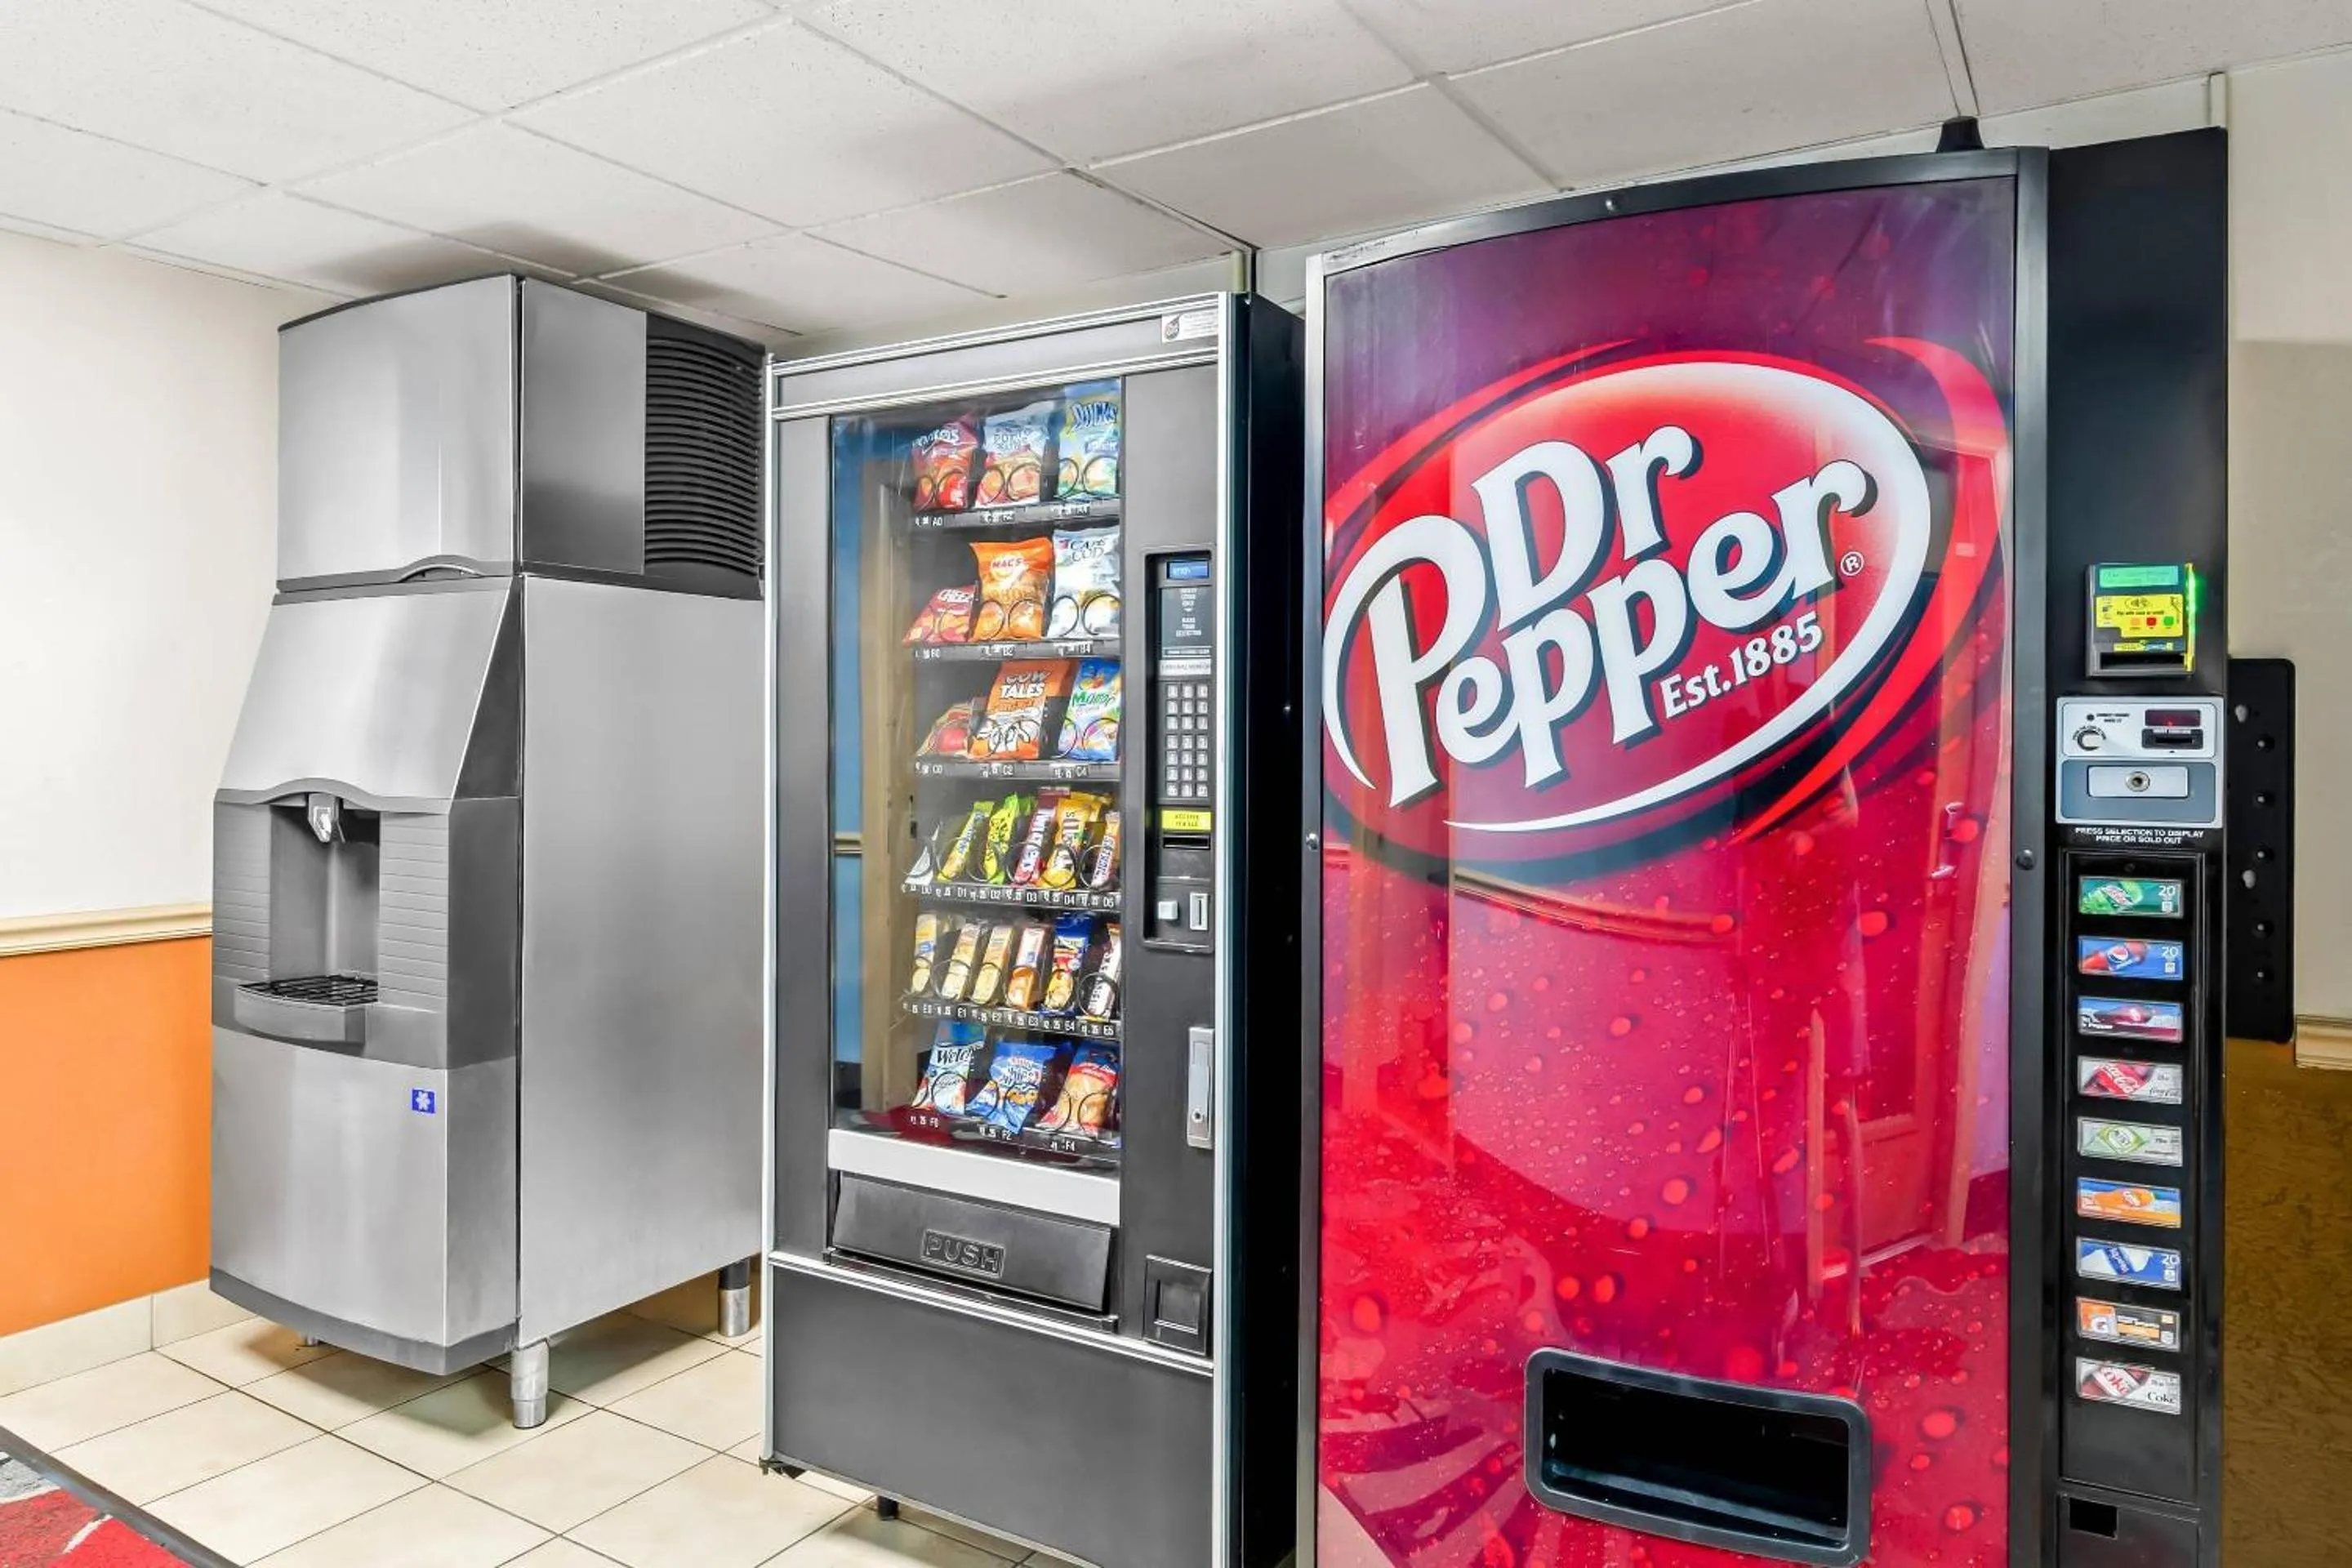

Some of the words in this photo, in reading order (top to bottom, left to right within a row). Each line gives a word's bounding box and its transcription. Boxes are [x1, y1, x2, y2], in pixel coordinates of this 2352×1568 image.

[1472, 425, 1695, 631] Dr
[1323, 459, 1869, 808] Pepper
[1000, 683, 1045, 699] TALES
[2075, 826, 2104, 835] PRESS
[2105, 827, 2153, 836] SELECTION
[2167, 830, 2204, 838] DISPLAY
[2163, 836, 2182, 844] OUT
[1026, 892, 1037, 902] D3
[2158, 884, 2176, 898] 20
[1064, 894, 1076, 905] D4
[2162, 946, 2179, 958] 20
[925, 1235, 1000, 1272] PUSH
[2160, 1254, 2180, 1265] 20
